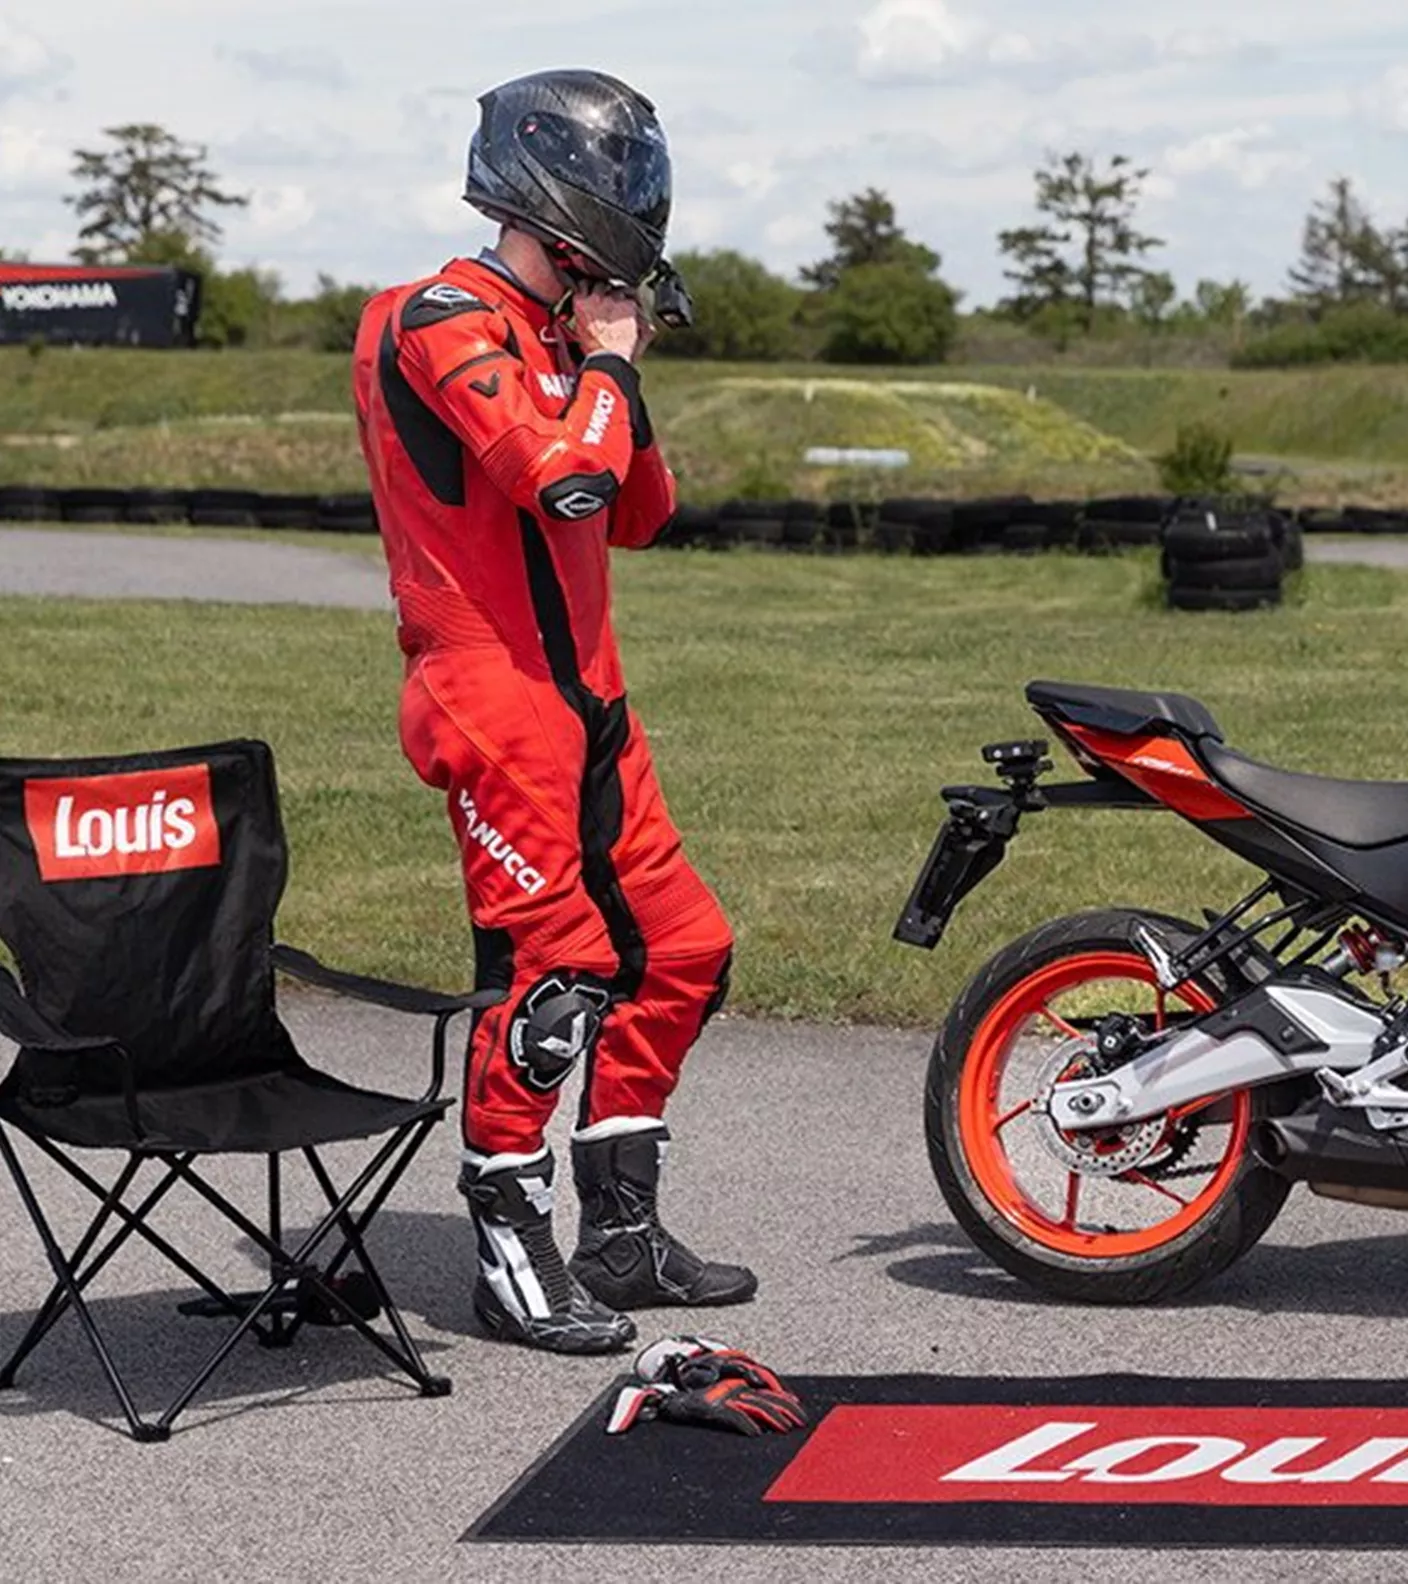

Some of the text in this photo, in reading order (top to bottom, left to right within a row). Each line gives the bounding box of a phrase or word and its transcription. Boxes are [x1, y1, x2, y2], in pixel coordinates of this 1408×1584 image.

[1, 282, 118, 311] YOKOHAMA
[55, 790, 197, 858] Louis
[459, 788, 547, 896] VANUCCI
